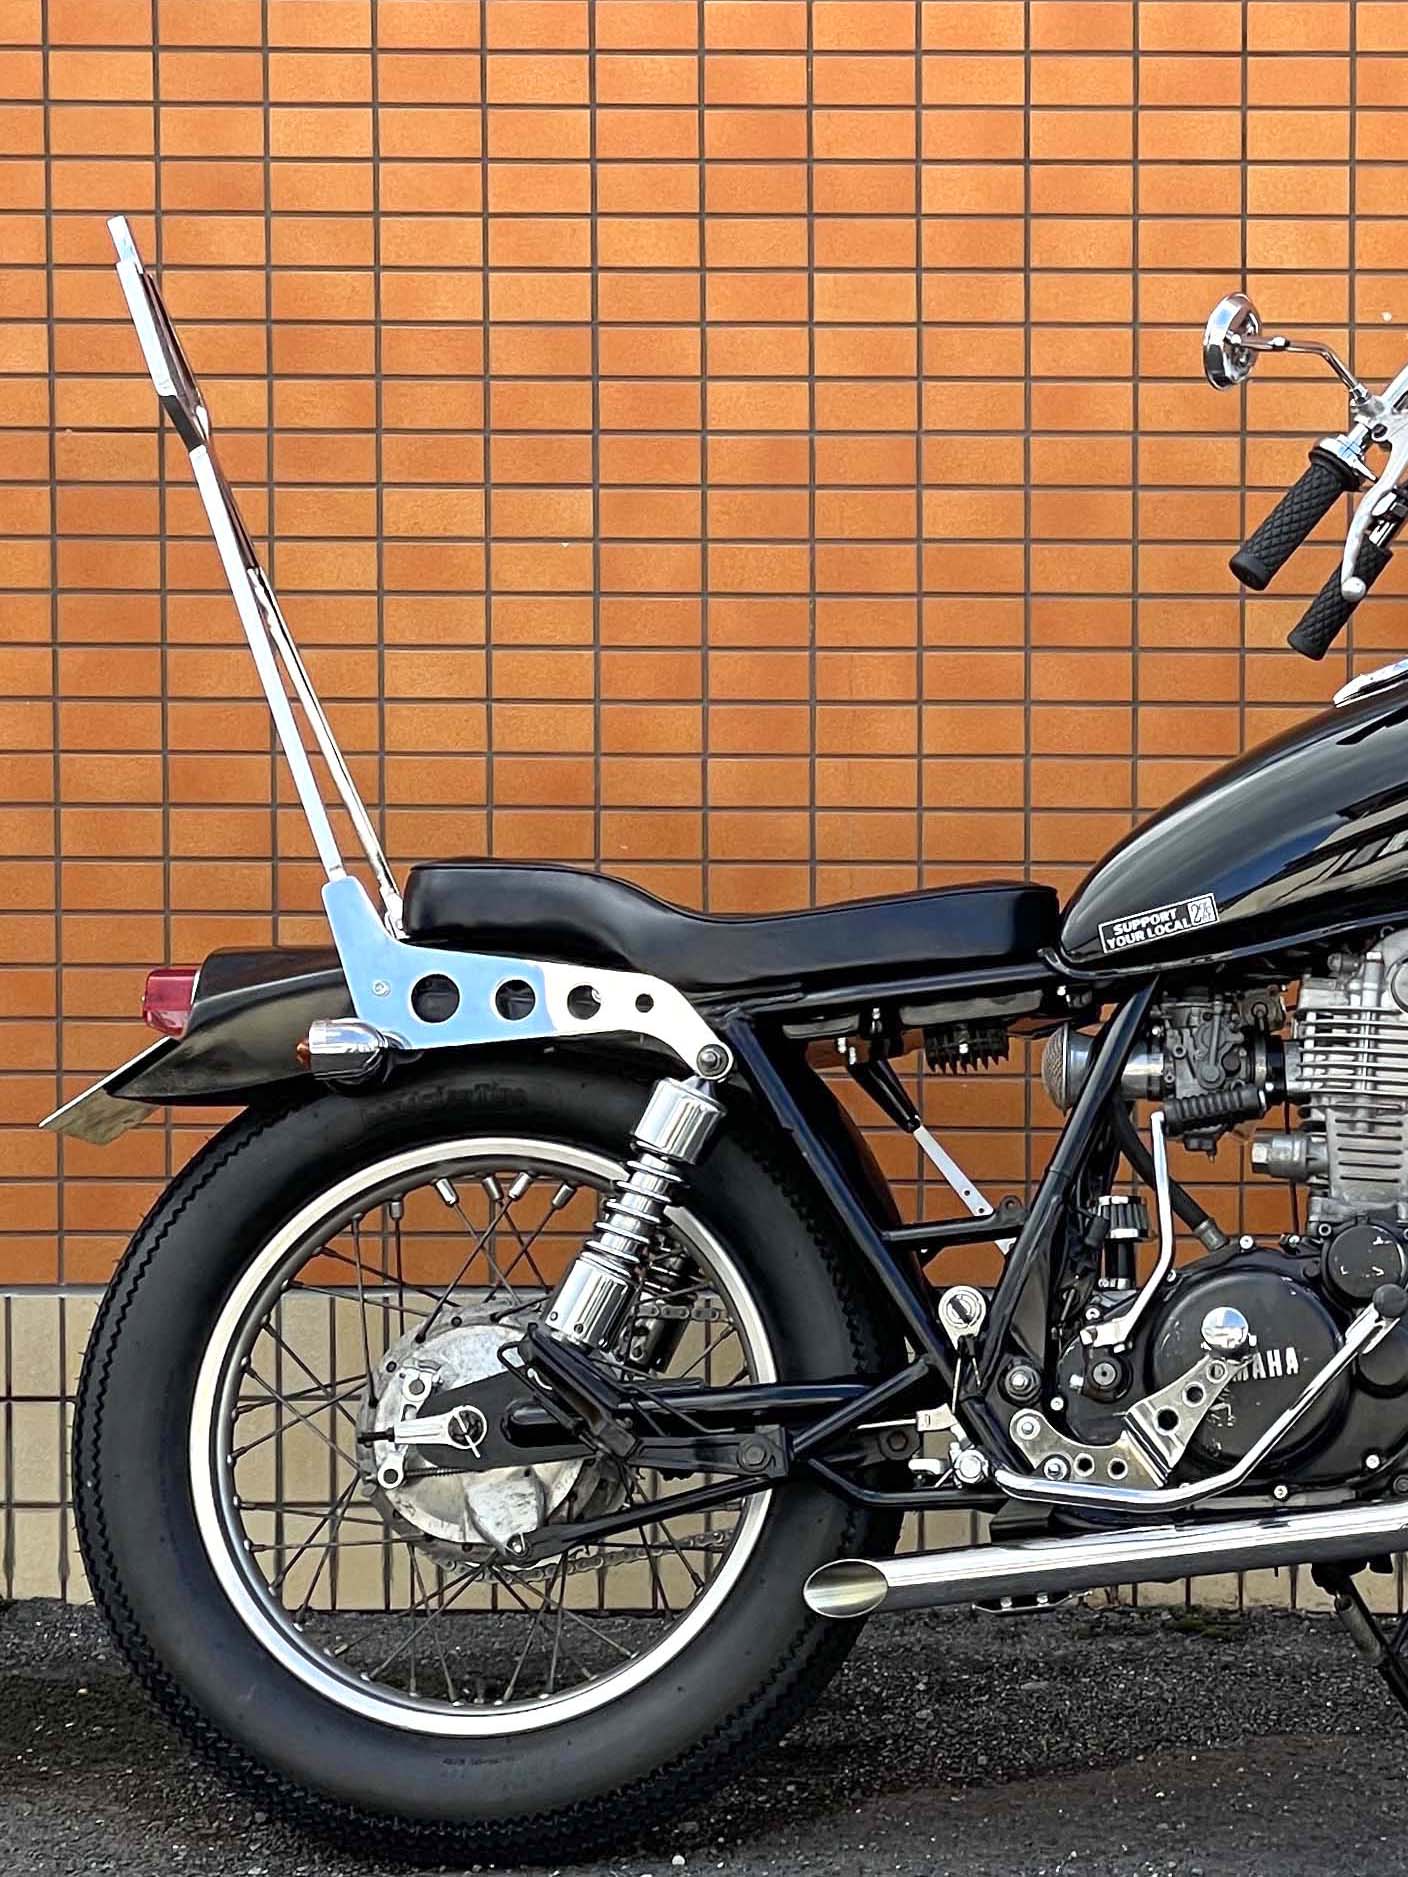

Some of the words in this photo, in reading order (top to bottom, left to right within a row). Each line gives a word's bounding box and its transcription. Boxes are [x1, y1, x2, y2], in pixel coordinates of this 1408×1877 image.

[1106, 931, 1145, 949] YOUR
[1146, 919, 1192, 938] LOCAL
[1113, 908, 1177, 936] SUPPORT
